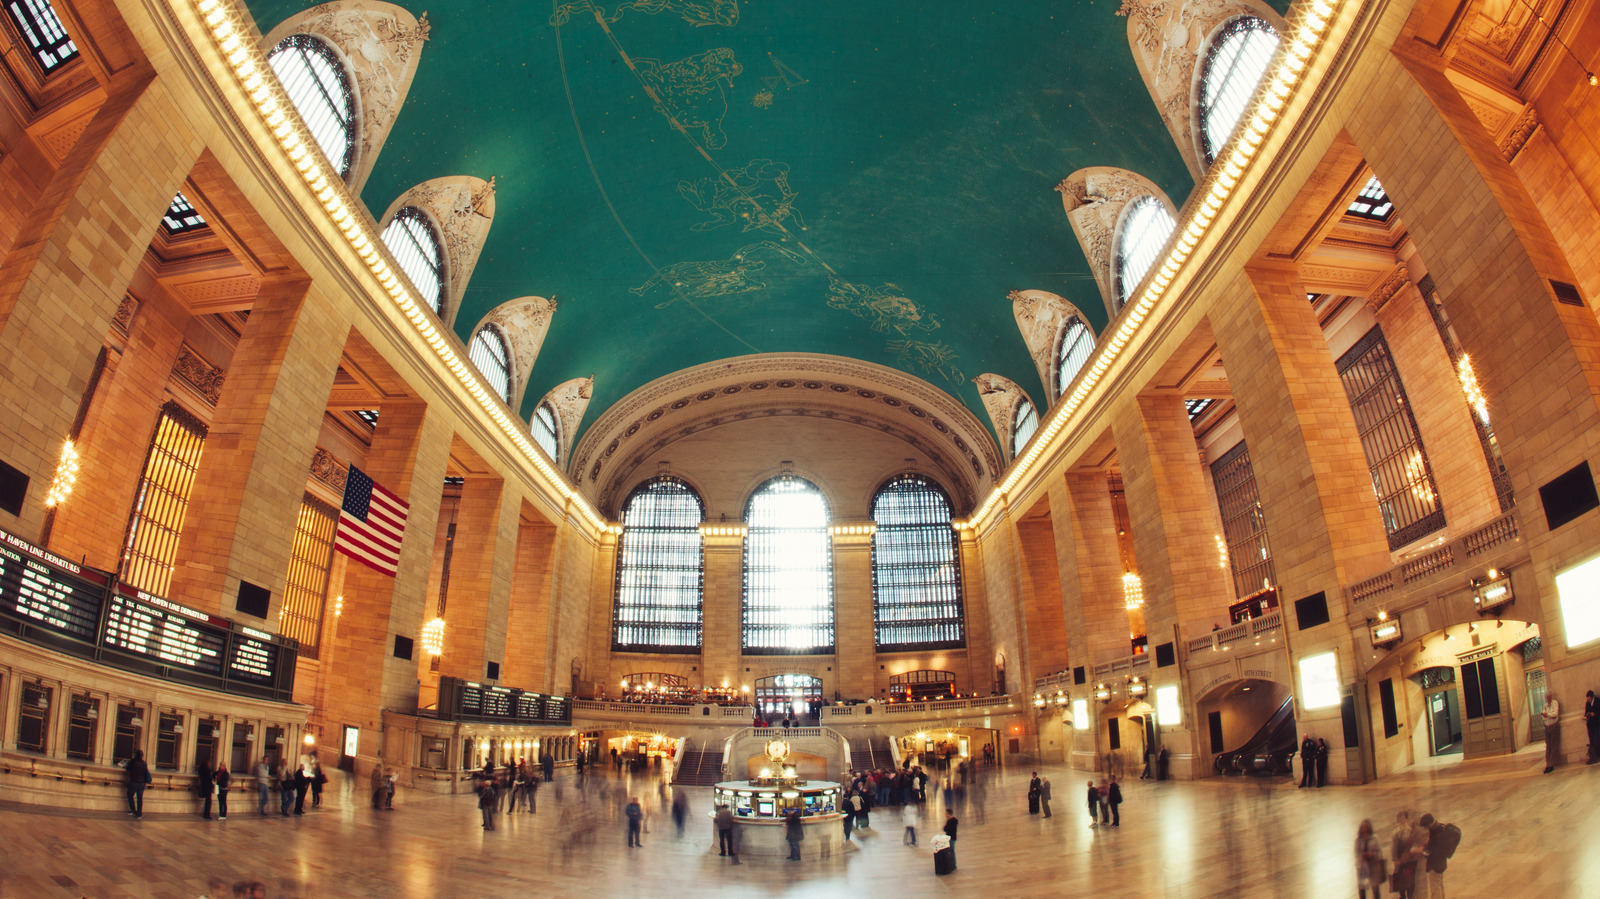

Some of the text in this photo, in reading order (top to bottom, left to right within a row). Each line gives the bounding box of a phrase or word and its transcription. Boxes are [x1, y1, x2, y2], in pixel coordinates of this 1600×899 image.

[7, 534, 29, 551] HAVEN
[29, 545, 44, 558] LINE
[44, 552, 80, 574] DEPARTURES
[27, 560, 50, 575] REMARKS
[137, 590, 151, 601] NEW
[150, 595, 168, 609] HAVEN
[168, 602, 180, 613] LINE
